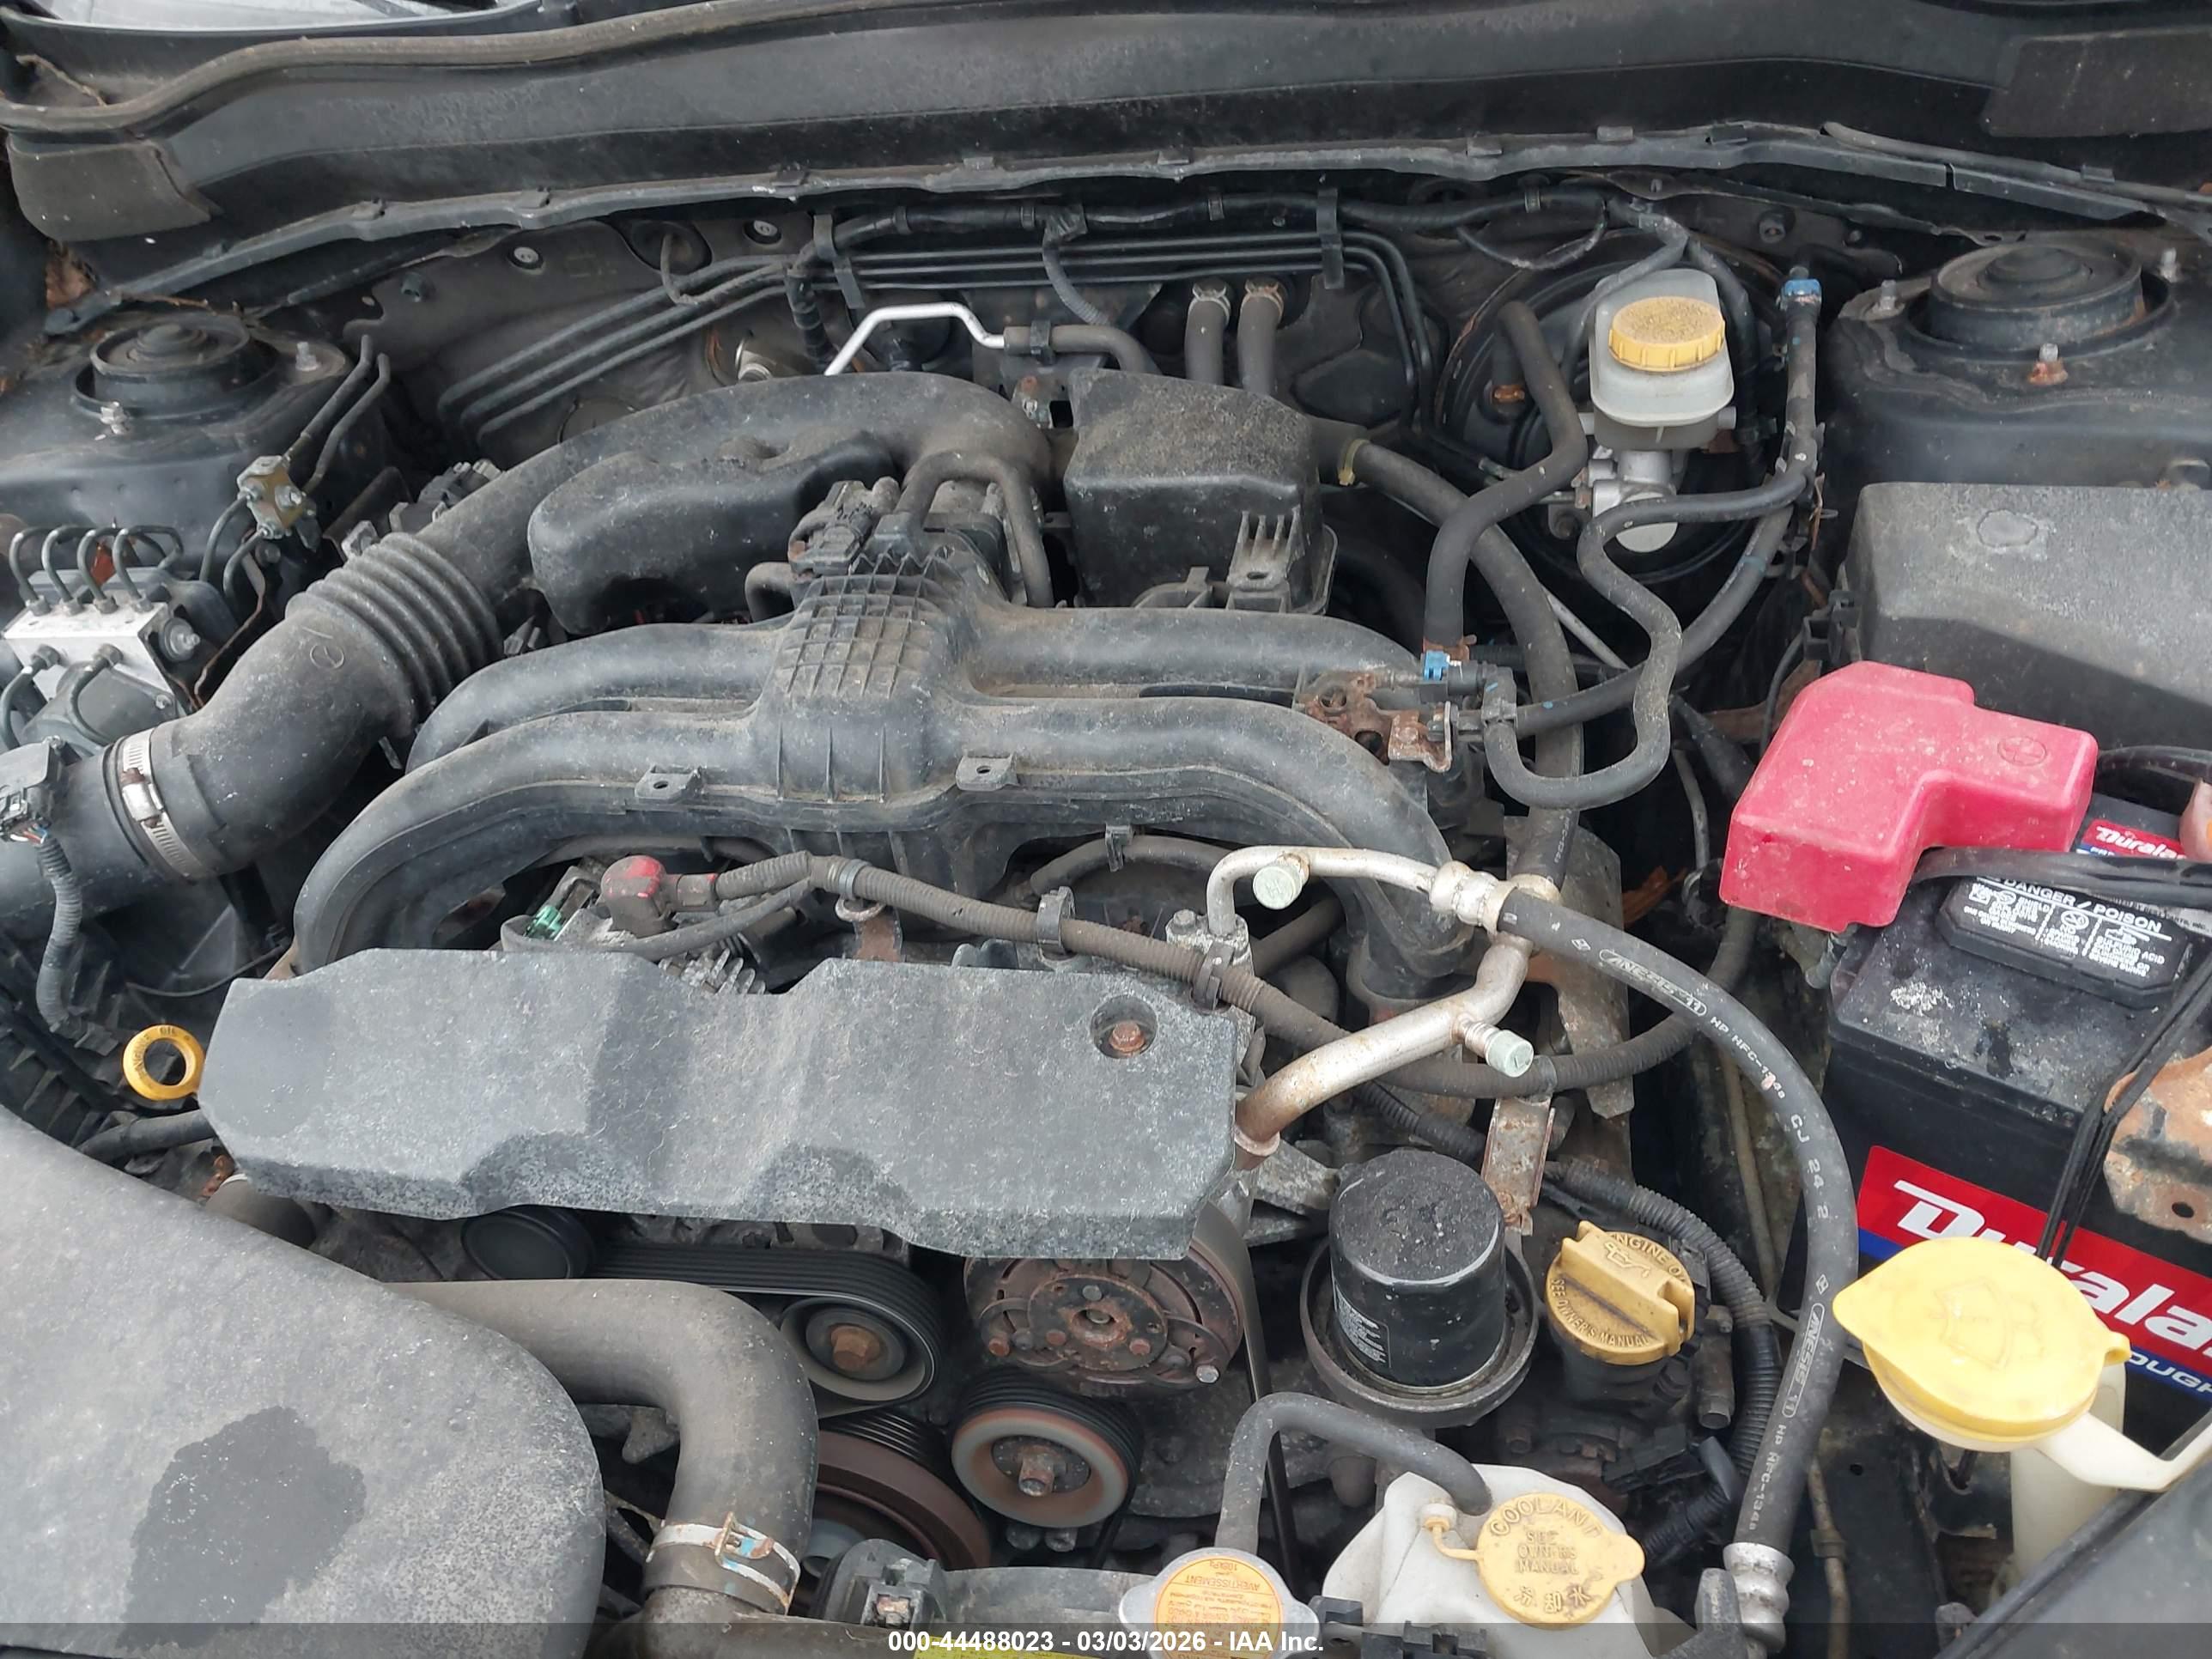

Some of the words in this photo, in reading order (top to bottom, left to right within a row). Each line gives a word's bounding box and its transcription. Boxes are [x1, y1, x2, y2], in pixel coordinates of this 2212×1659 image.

[2003, 878, 2075, 908] DANGER
[2093, 903, 2162, 933] POISON
[2141, 951, 2166, 965] ACID
[1710, 1016, 1729, 1033] HP
[1551, 1278, 1567, 1298] SEE
[1599, 1331, 1650, 1348] MANUAL
[1774, 1424, 1787, 1445] HP
[1489, 1498, 1604, 1538] COOLANT
[1526, 1530, 1559, 1546] SEE
[1516, 1559, 1580, 1575] MANUAL
[1184, 1574, 1261, 1592] AVERTISSEMENT
[1514, 1585, 1591, 1613] 冷却水
